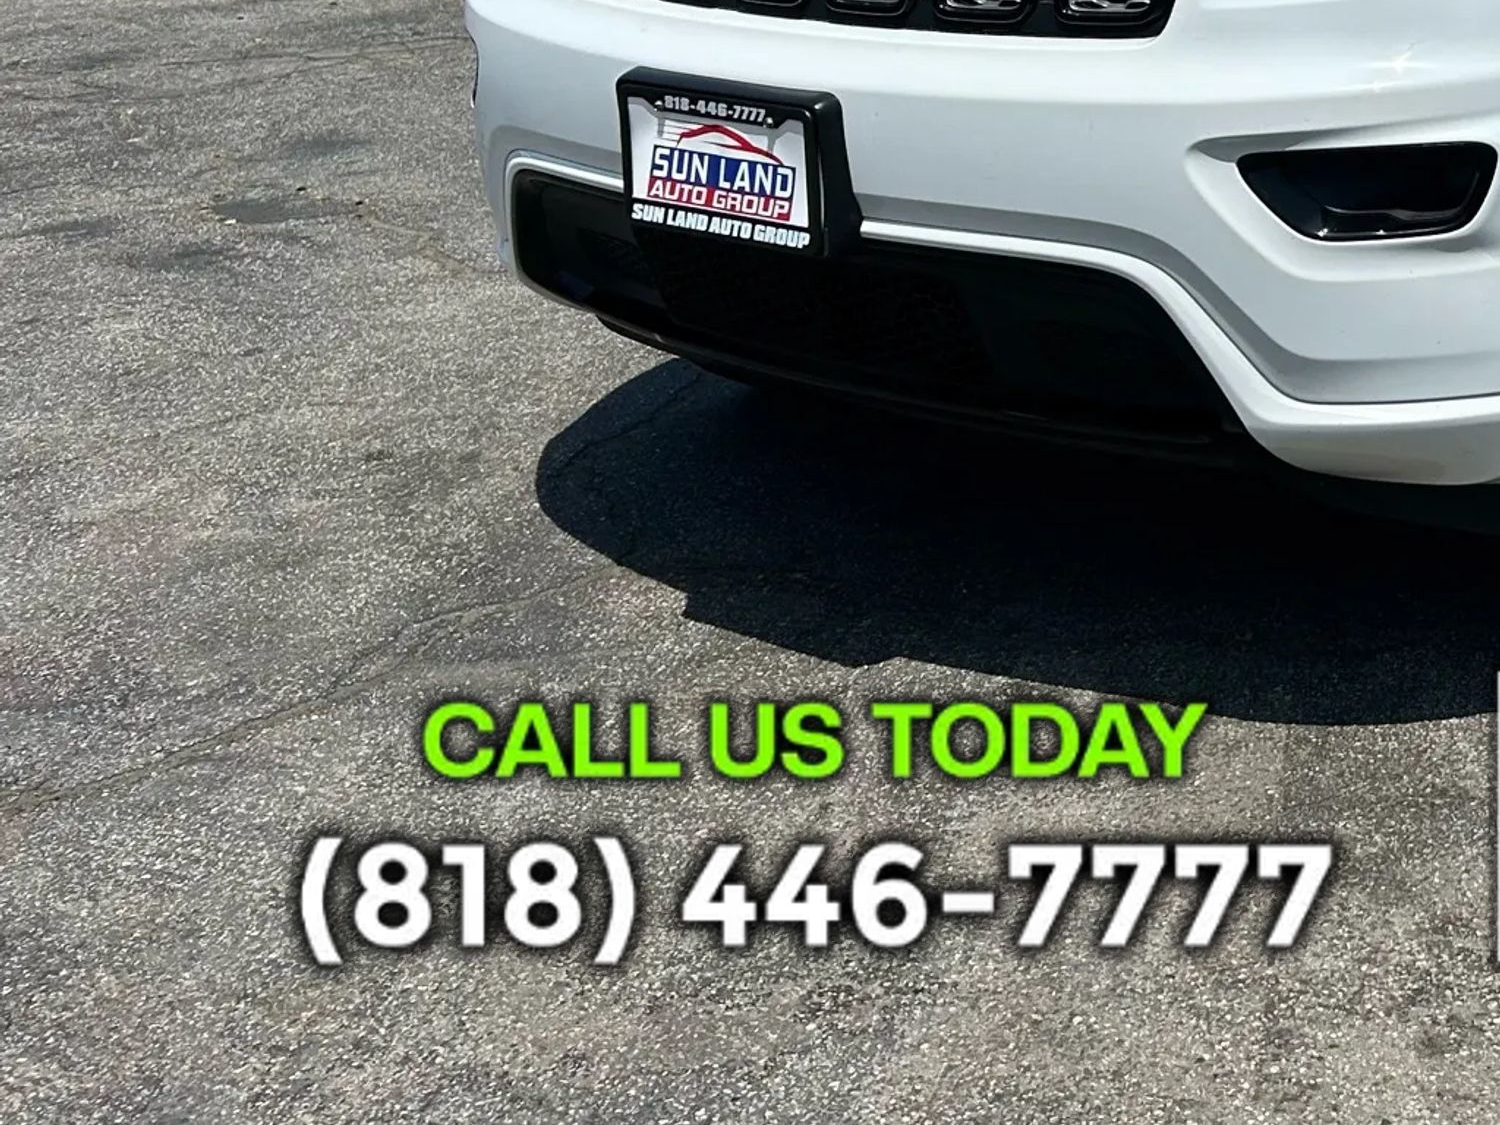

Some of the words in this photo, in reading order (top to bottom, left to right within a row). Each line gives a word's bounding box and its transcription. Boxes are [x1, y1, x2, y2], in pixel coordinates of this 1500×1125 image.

[664, 95, 767, 123] 818-446-7777
[651, 146, 709, 185] SUN
[718, 158, 794, 199] LAND
[649, 179, 708, 205] AUTO
[711, 190, 792, 219] GROUP
[631, 202, 665, 224] SUN
[666, 208, 708, 232] LAND
[708, 216, 753, 239] AUTO
[753, 224, 811, 249] GROUP
